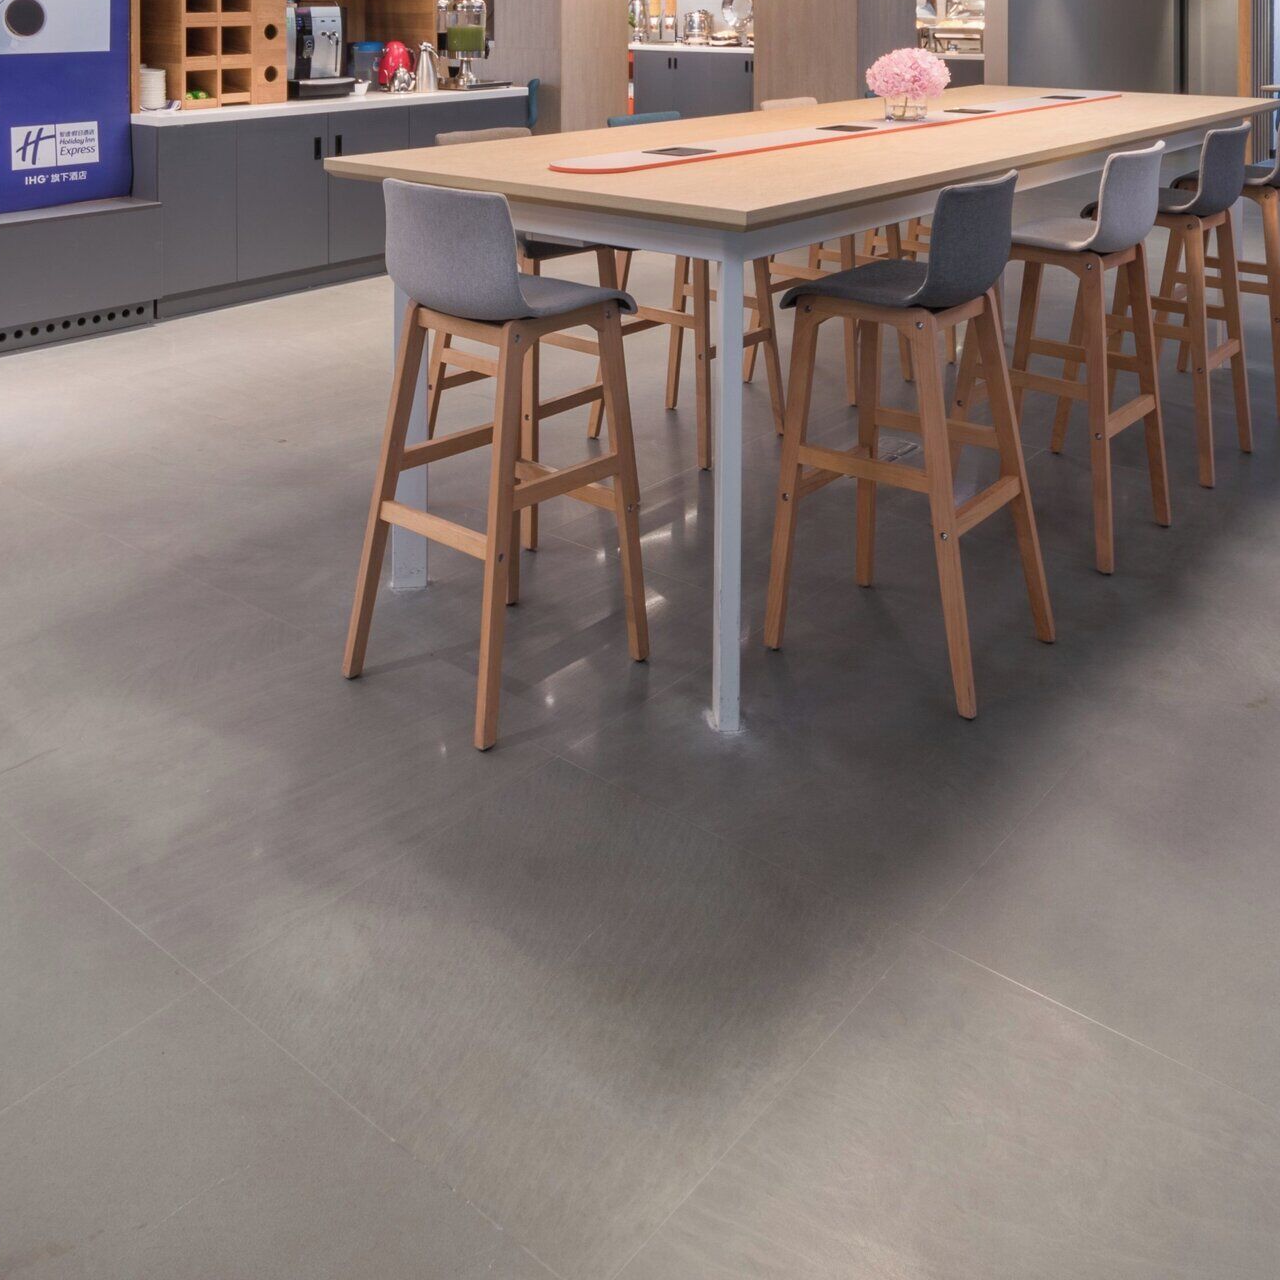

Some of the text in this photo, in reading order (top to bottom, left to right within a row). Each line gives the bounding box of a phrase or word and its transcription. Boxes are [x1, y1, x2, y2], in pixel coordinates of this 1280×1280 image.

[60, 146, 96, 157] Express
[50, 171, 87, 183] 旗下酒店
